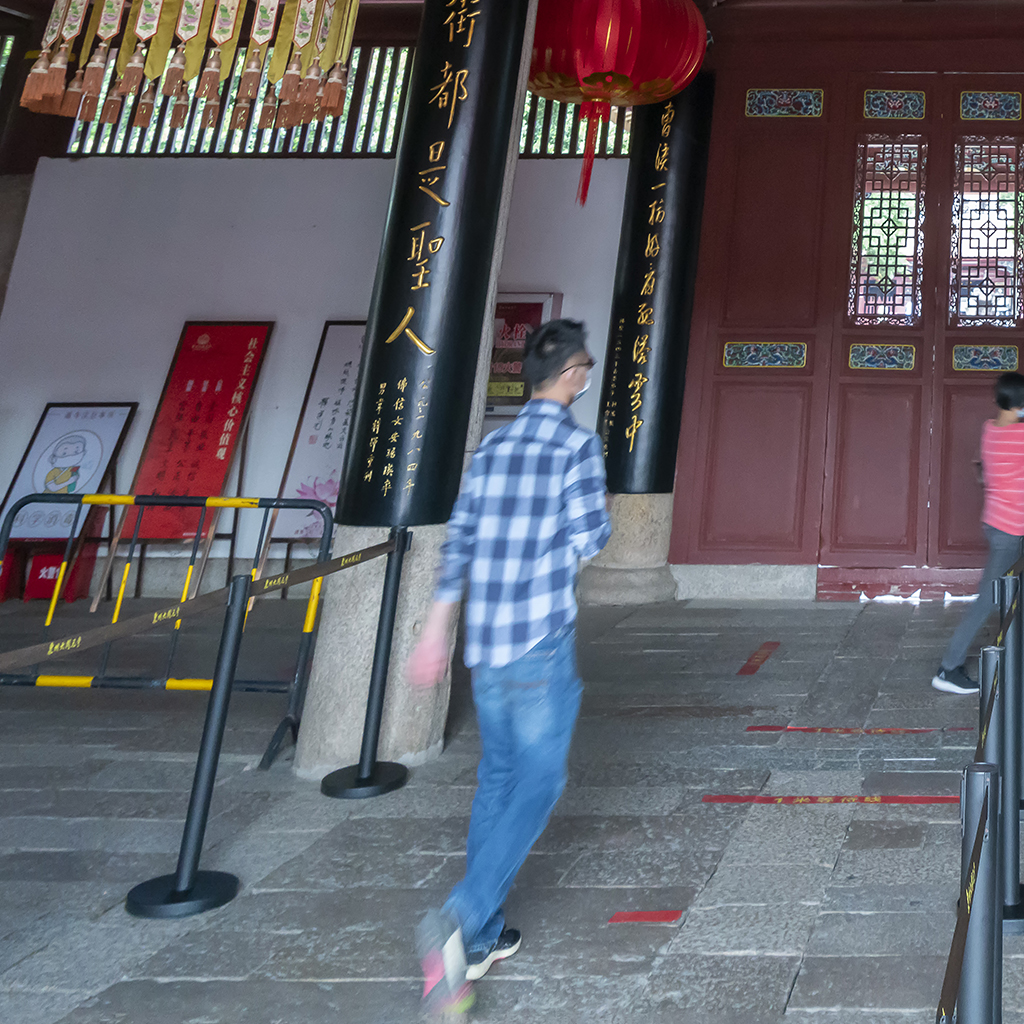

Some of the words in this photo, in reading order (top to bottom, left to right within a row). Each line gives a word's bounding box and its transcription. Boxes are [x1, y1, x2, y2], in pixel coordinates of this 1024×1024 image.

[216, 337, 258, 460] 社会主义核心价值观
